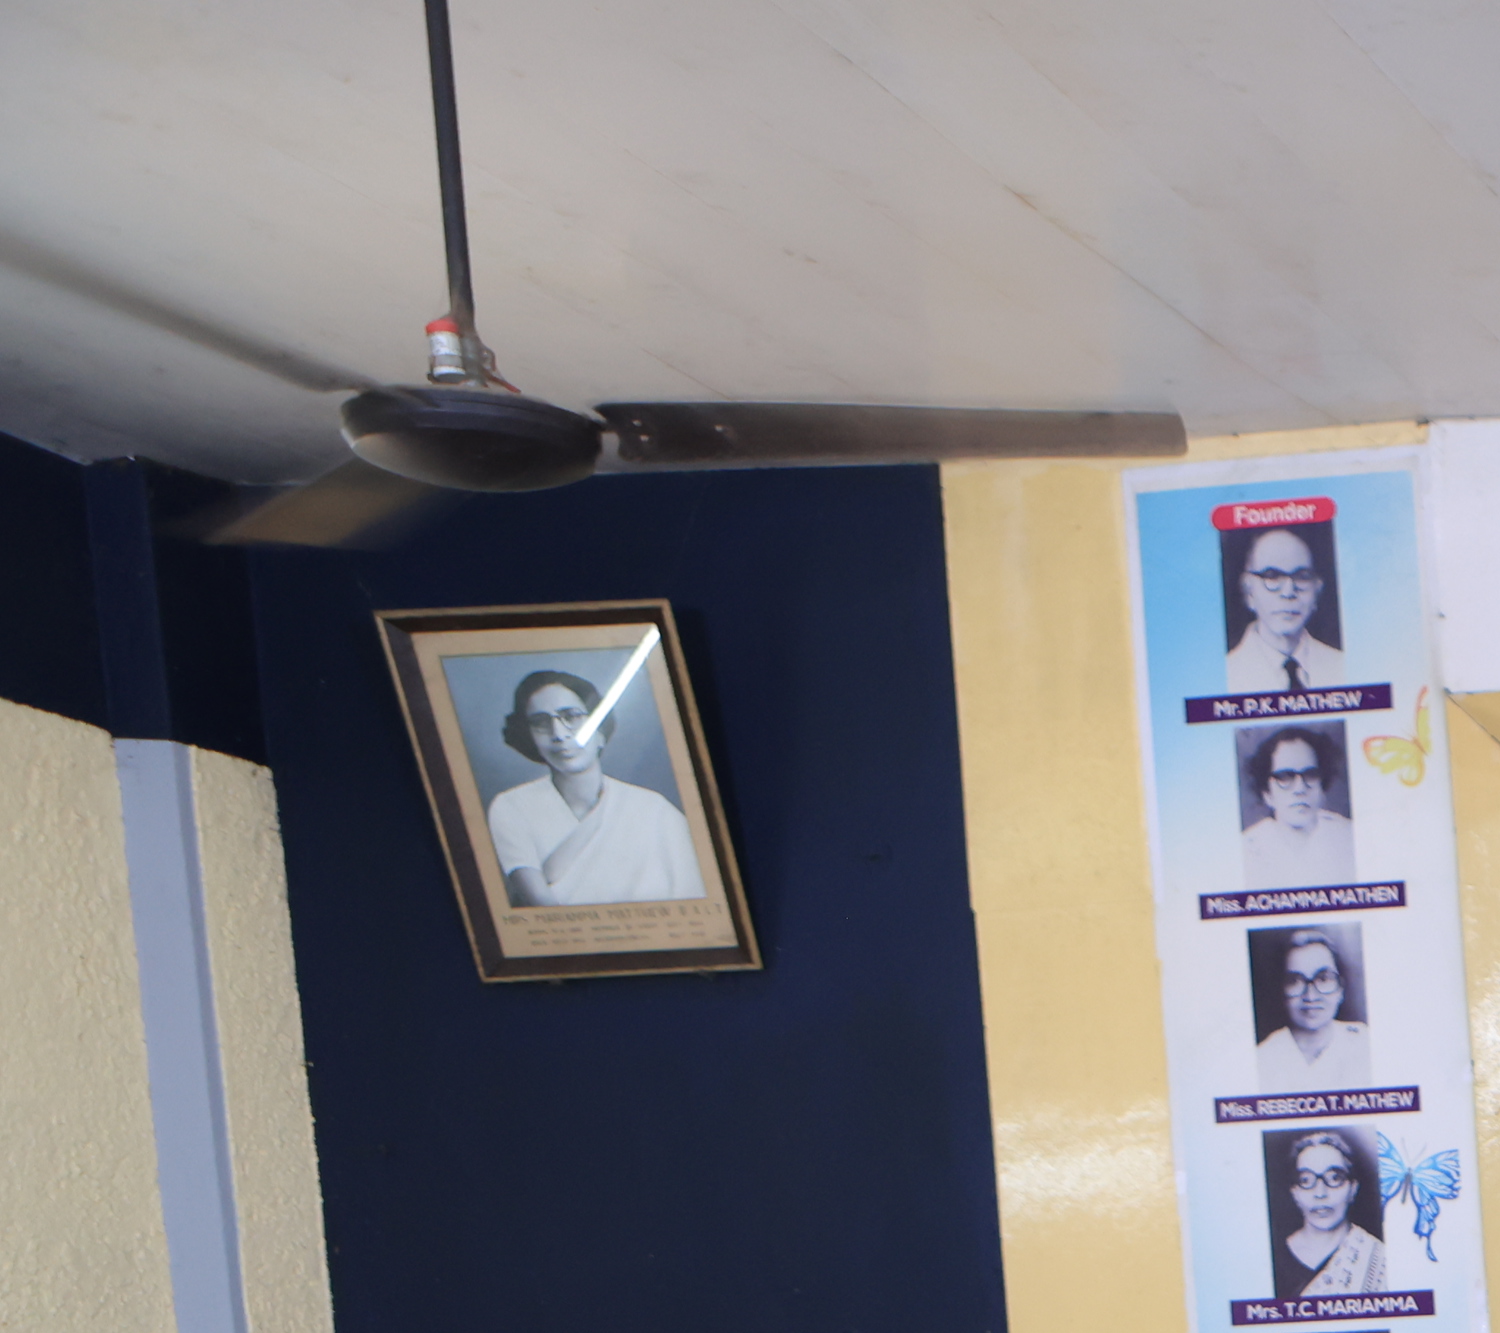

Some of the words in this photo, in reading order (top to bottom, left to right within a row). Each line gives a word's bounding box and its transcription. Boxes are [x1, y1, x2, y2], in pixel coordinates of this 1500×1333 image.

[1232, 501, 1317, 526] Founder
[1213, 699, 1244, 718] Mr.
[1244, 696, 1279, 716] P.K.
[1280, 690, 1363, 713] MATHEW
[1206, 896, 1246, 914] Miss.
[1245, 889, 1331, 911] ACHAMMA
[1219, 1101, 1258, 1118] Miss.
[1256, 1096, 1328, 1116] REBECCA
[1326, 1095, 1343, 1112] T.
[1343, 1090, 1415, 1111] MATHEW
[1246, 1303, 1283, 1320] Mrs.
[1284, 1300, 1316, 1317] T.C.
[1318, 1295, 1419, 1316] MARIAMMA
